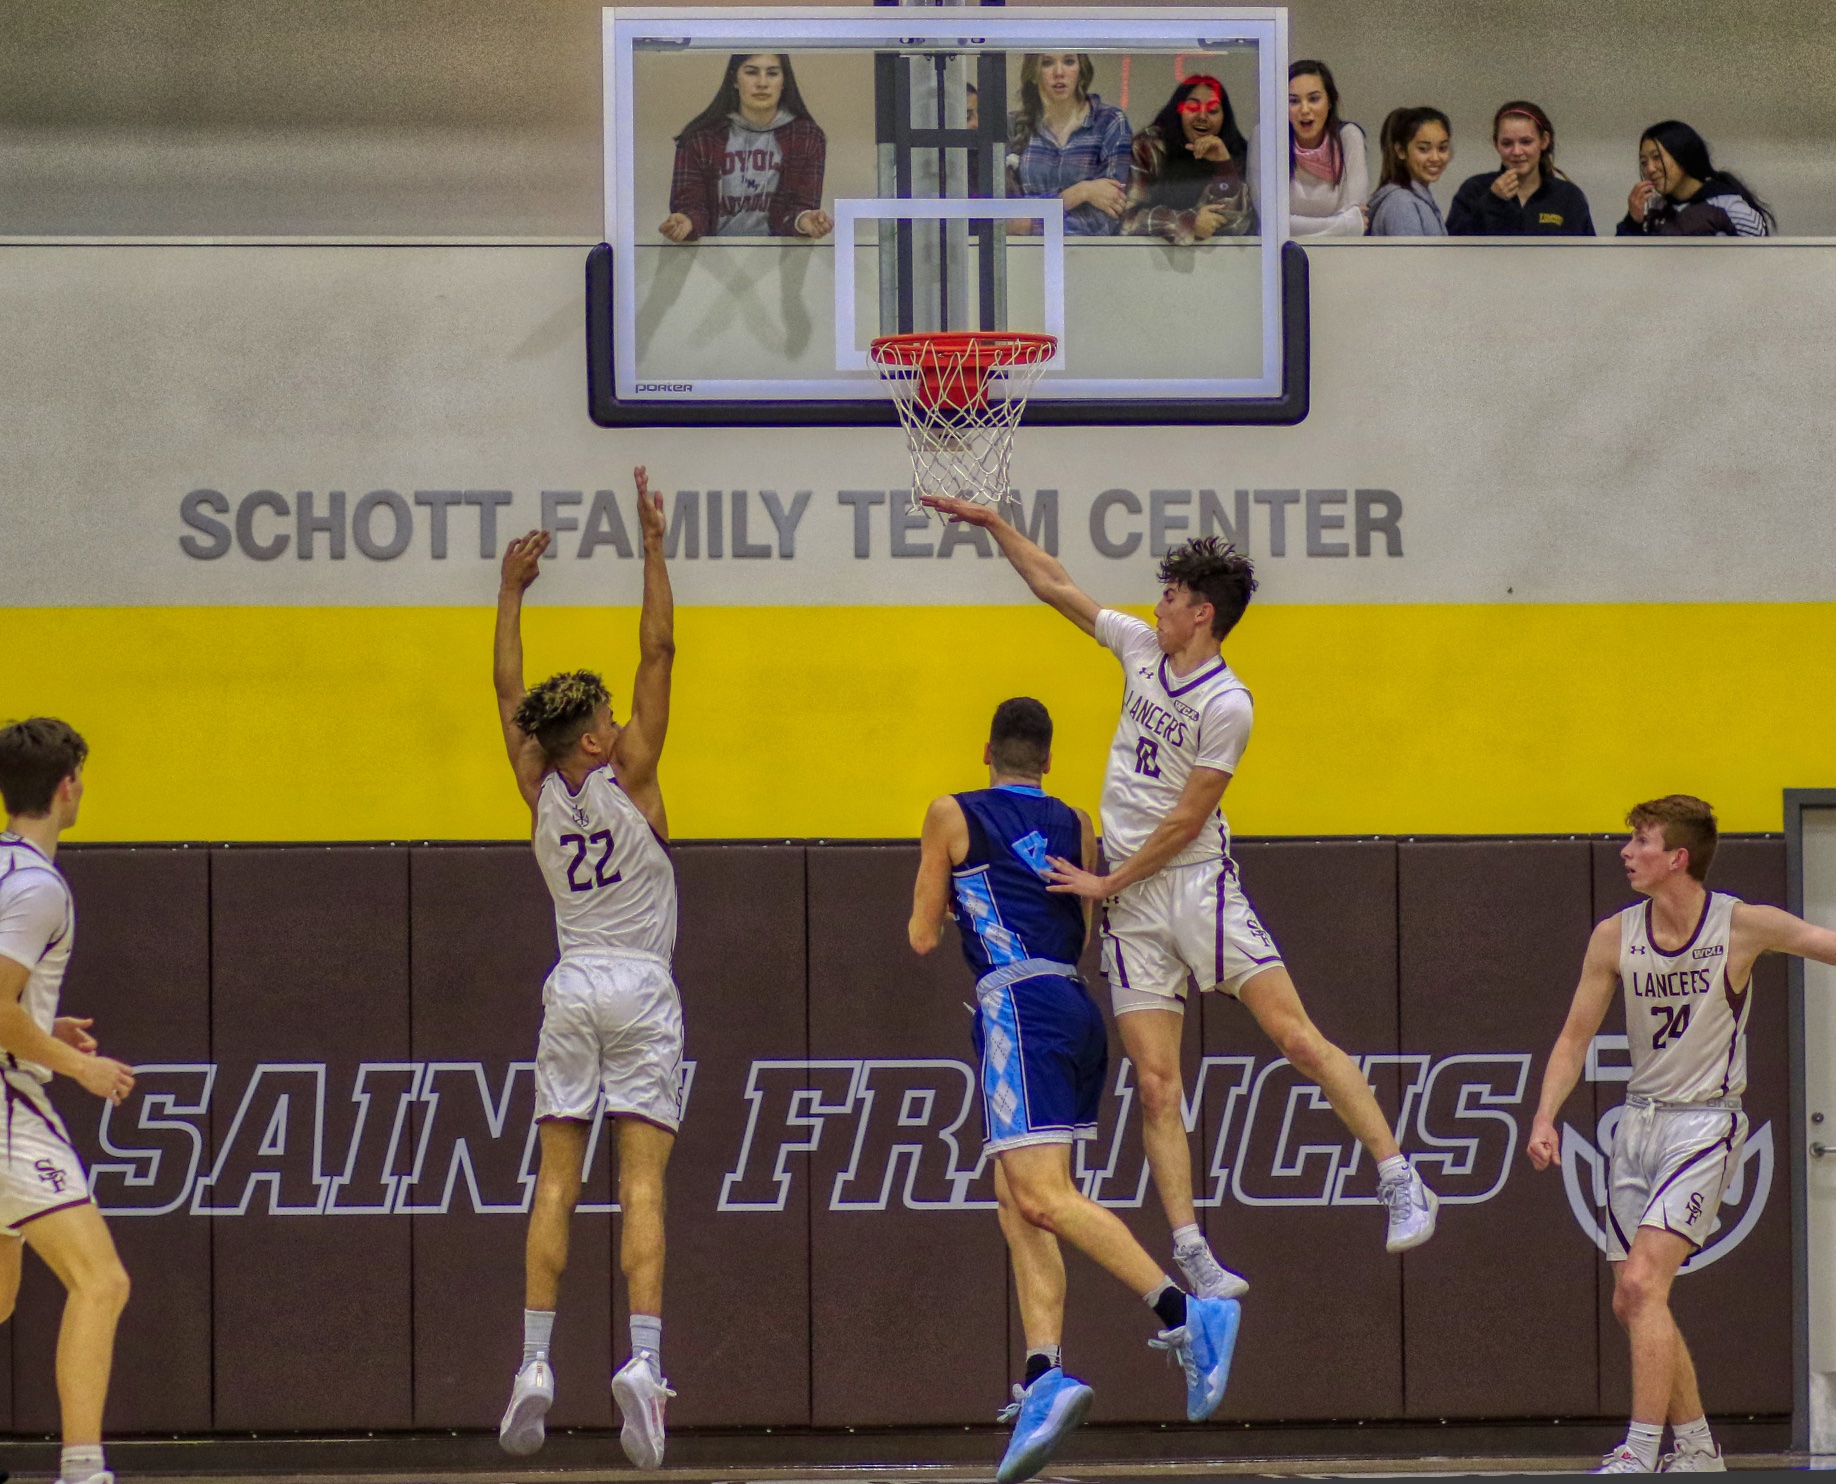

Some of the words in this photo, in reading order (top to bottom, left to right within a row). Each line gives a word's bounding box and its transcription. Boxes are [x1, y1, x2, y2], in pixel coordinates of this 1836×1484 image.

[179, 489, 513, 560] SCHOTT
[1089, 489, 1404, 559] CENTER
[560, 829, 622, 892] 22
[1692, 945, 1724, 960] WCAL
[1651, 1004, 1690, 1050] 24
